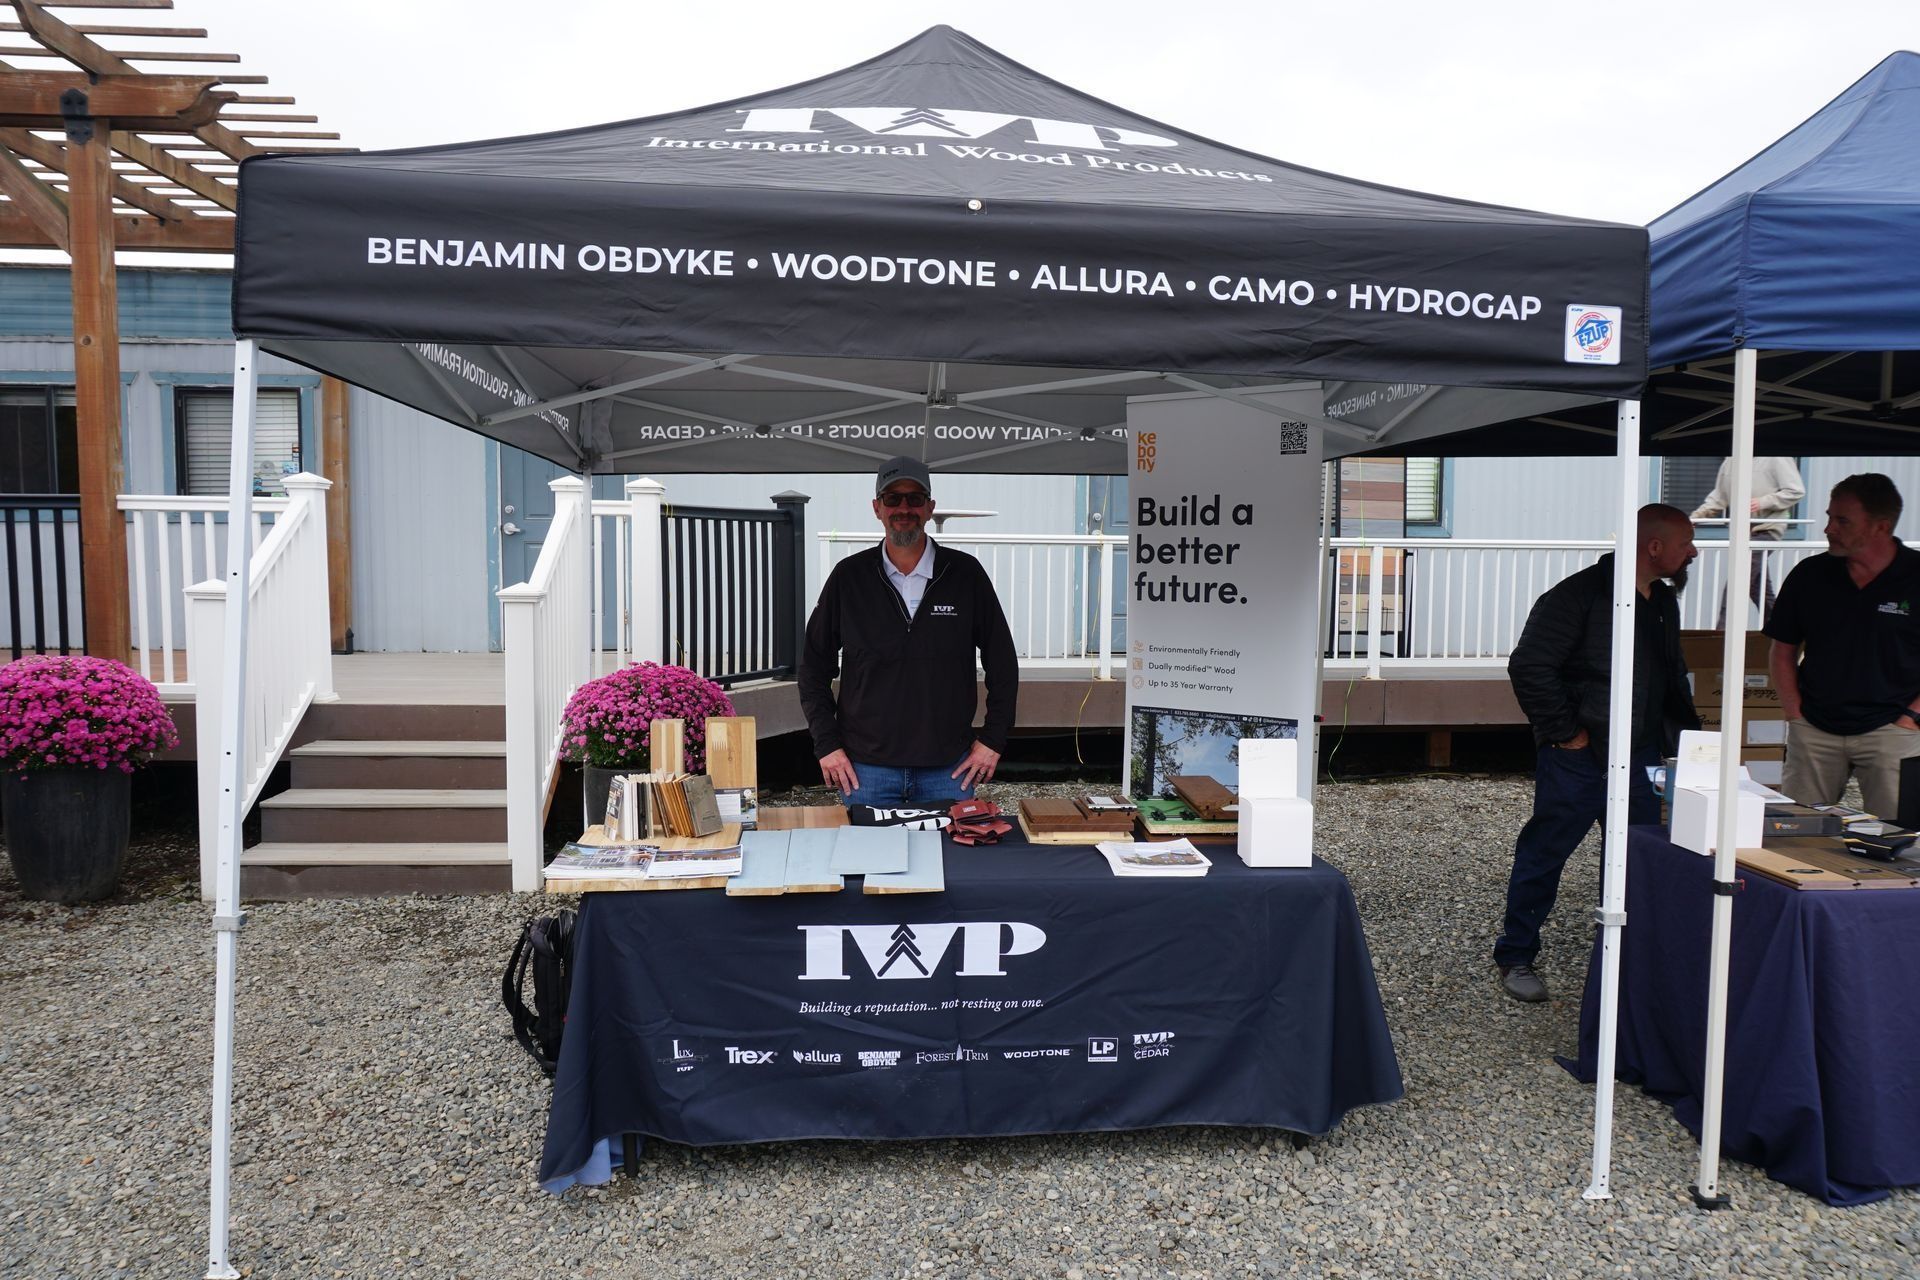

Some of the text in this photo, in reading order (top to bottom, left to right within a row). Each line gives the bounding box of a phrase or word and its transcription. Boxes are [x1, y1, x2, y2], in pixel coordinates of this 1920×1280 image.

[725, 107, 1178, 151] IWP
[645, 136, 1273, 182] International Wood Products
[367, 237, 565, 270] BENJAMIN
[577, 244, 735, 276] OBDYKE
[771, 252, 996, 287] WOODTONE
[1030, 264, 1175, 297] ALLURA
[1208, 275, 1315, 306] CAMO
[1349, 283, 1542, 321] HYDROGAP
[1137, 494, 1253, 527] Build a
[1136, 533, 1241, 565] better
[1134, 571, 1248, 605] future.
[1148, 645, 1240, 658] Environmentally Friendly
[1148, 662, 1172, 672] Dually
[1213, 666, 1236, 675] Wood
[1148, 680, 1159, 688] Up
[1180, 682, 1197, 690] Year
[1199, 683, 1234, 694] Warranty
[797, 921, 1047, 980] IWP
[799, 997, 1045, 1016] Building a reputation... not resting on one.
[1132, 1032, 1175, 1045] IWP
[1003, 1049, 1071, 1059] WOODTONE
[1091, 1041, 1115, 1055] LP
[1134, 1048, 1170, 1060] CEDAR
[804, 1050, 842, 1063] allura
[858, 1051, 901, 1060] BENJAMIN
[861, 1059, 898, 1067] OBDYKE
